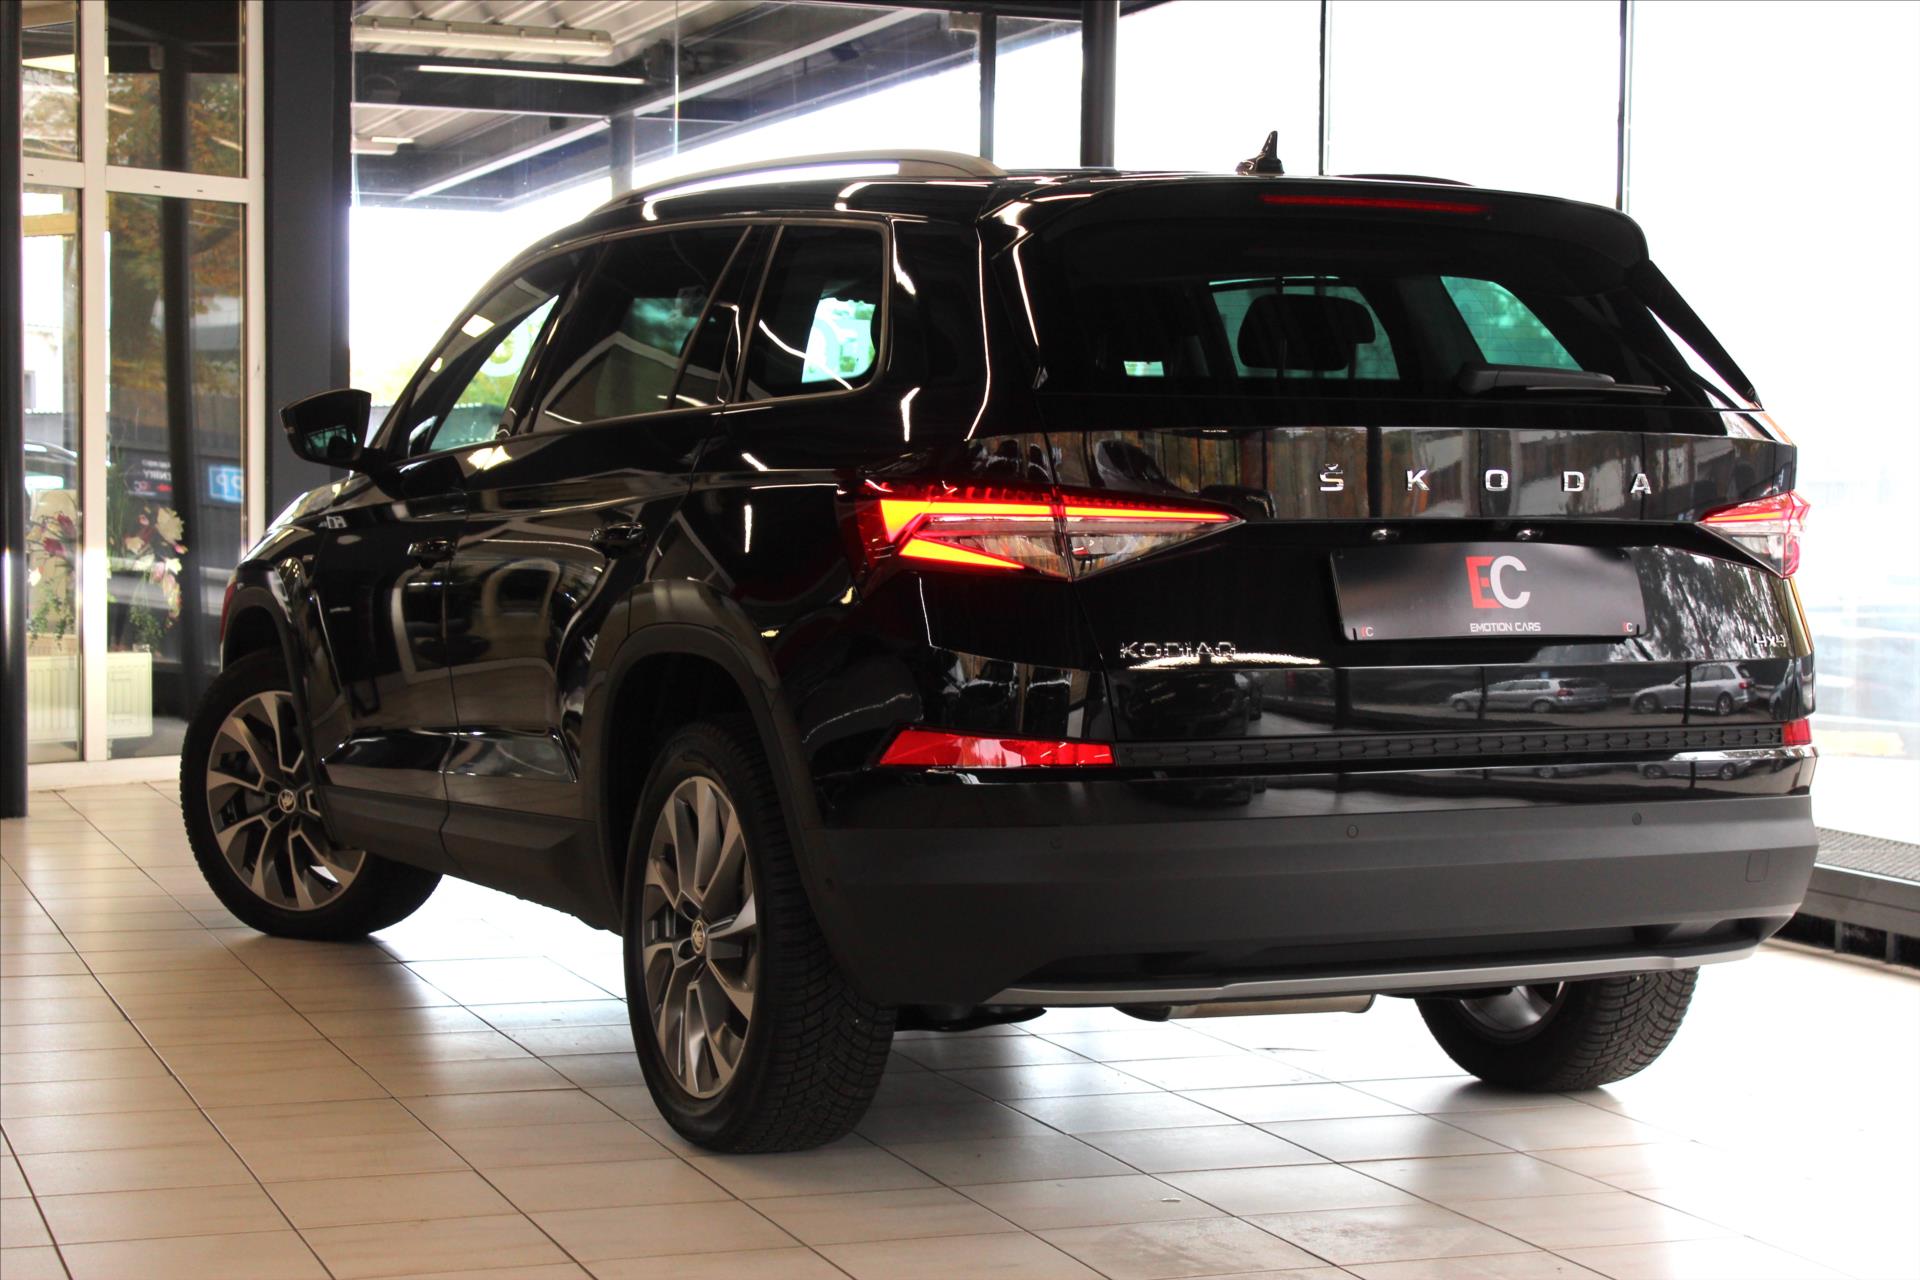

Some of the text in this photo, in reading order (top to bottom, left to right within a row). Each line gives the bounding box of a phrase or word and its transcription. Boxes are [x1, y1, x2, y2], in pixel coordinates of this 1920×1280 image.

[1319, 463, 1652, 494] ŠKODA
[1465, 555, 1531, 609] EC
[1469, 622, 1542, 632] EMOTION CARS
[1120, 641, 1237, 660] KODIAQ
